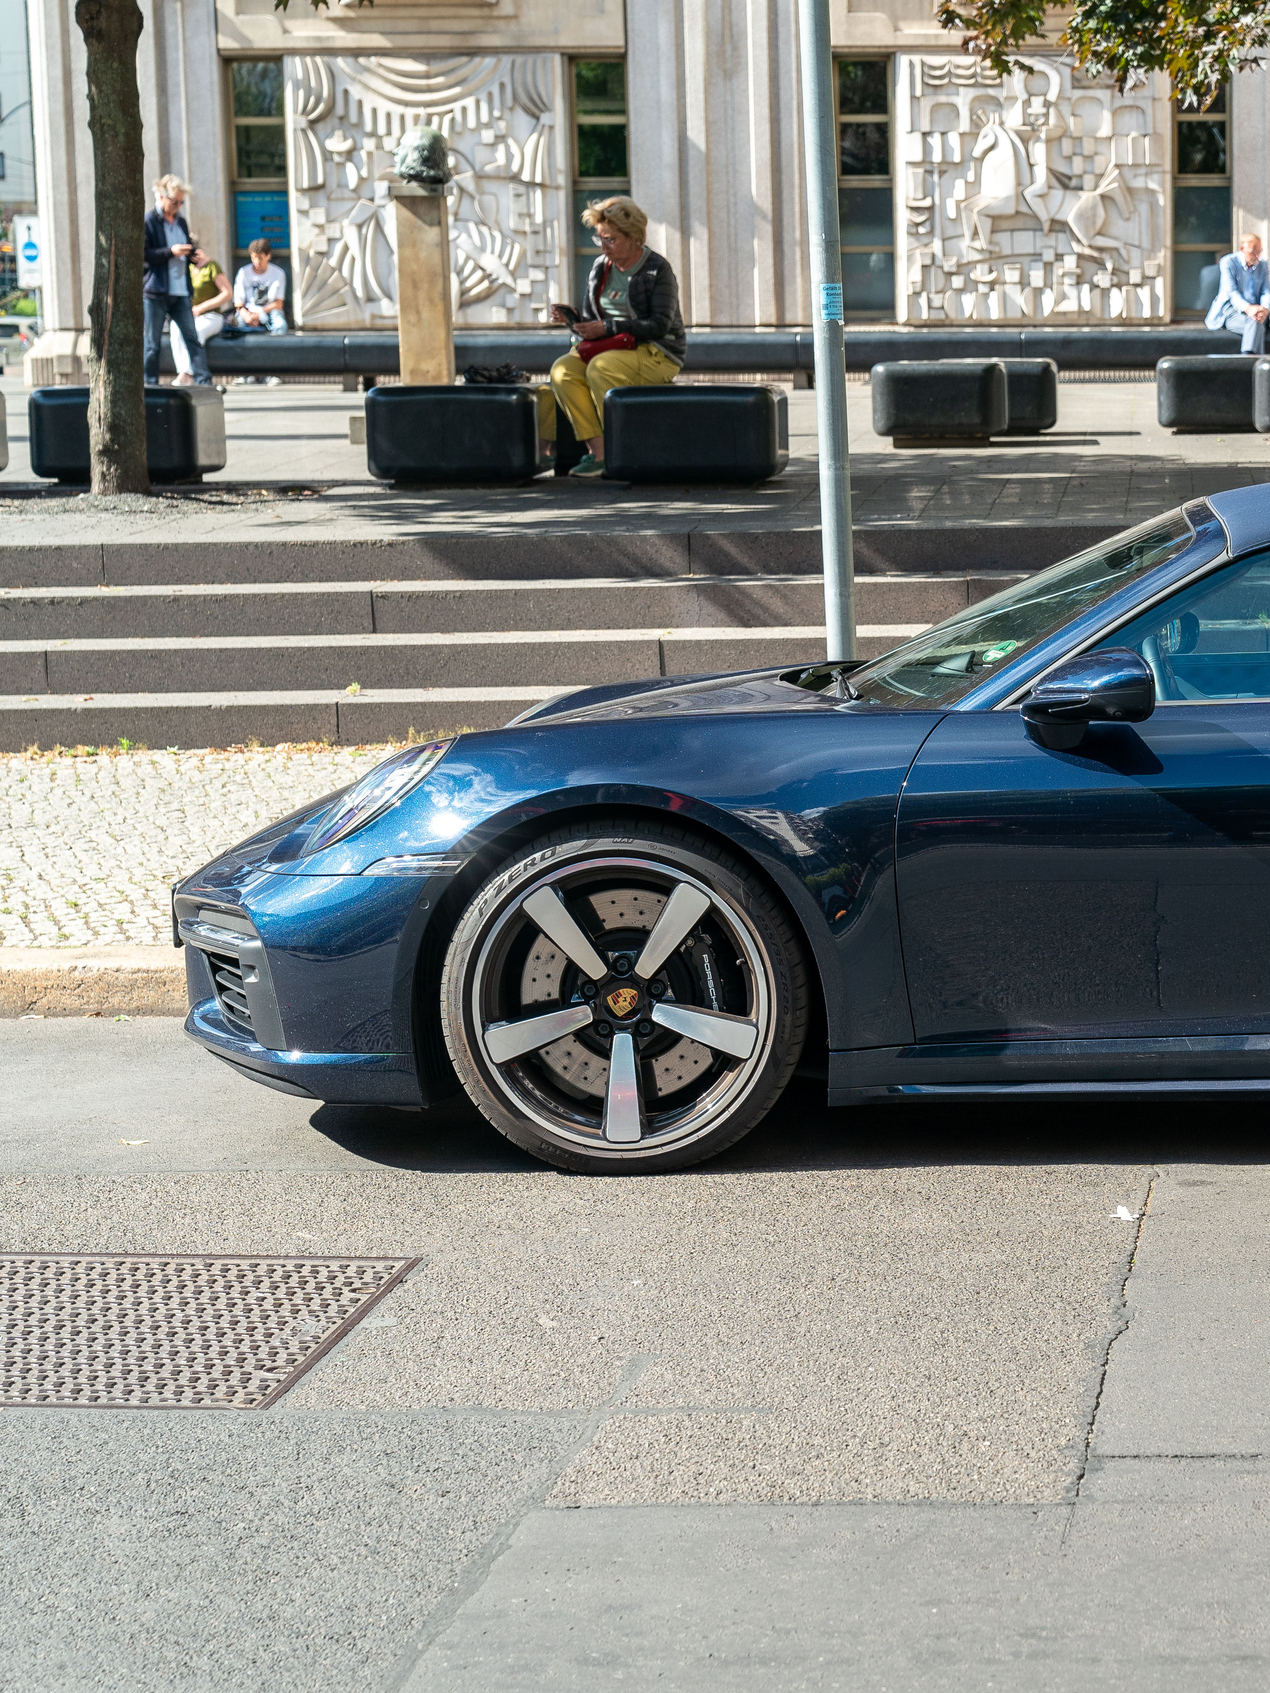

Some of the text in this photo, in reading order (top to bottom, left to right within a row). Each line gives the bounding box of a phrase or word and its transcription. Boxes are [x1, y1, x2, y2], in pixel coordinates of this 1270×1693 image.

[477, 845, 557, 918] P ZERO
[702, 954, 720, 1012] PORSCHE
